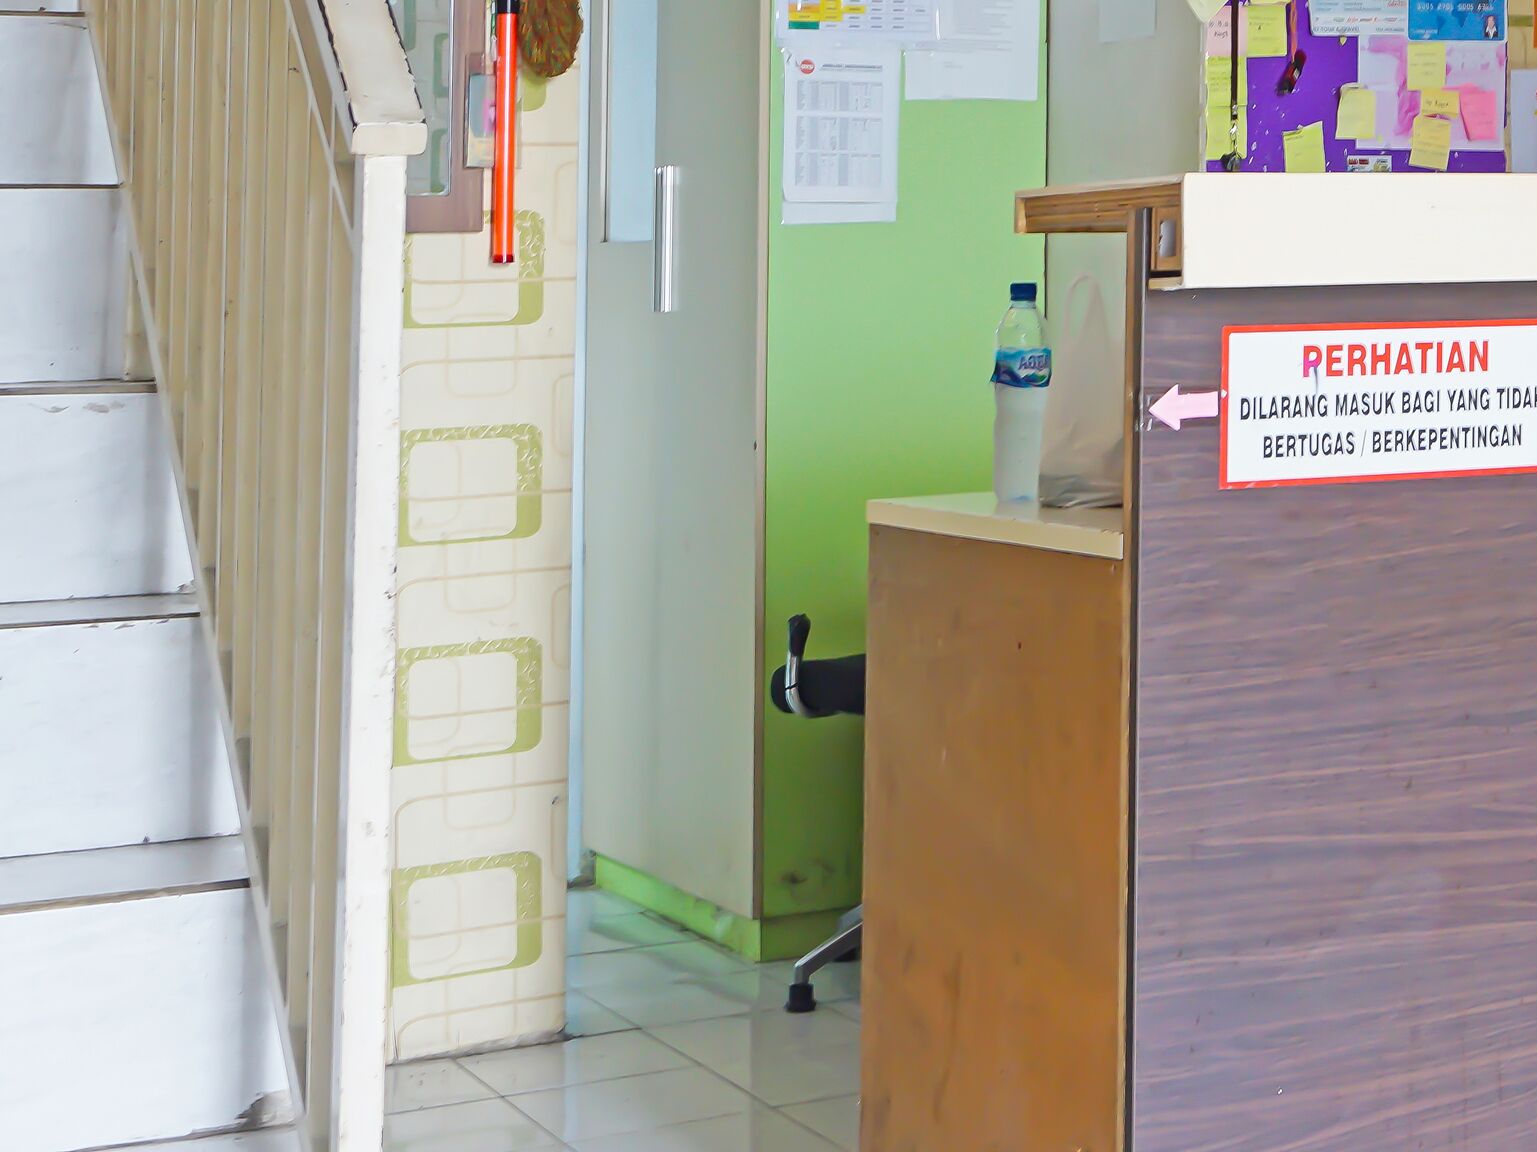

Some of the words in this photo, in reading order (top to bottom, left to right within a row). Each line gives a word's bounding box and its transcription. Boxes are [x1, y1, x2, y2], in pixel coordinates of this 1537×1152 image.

[1302, 340, 1489, 378] PERHATIAN
[1239, 393, 1328, 421] DILARANG
[1335, 390, 1396, 417] MASUK
[1401, 389, 1440, 414] BAGI
[1447, 387, 1490, 412] YANG
[1263, 430, 1355, 459] BERTUGAS
[1372, 424, 1523, 453] BERKEPENTINGAN
